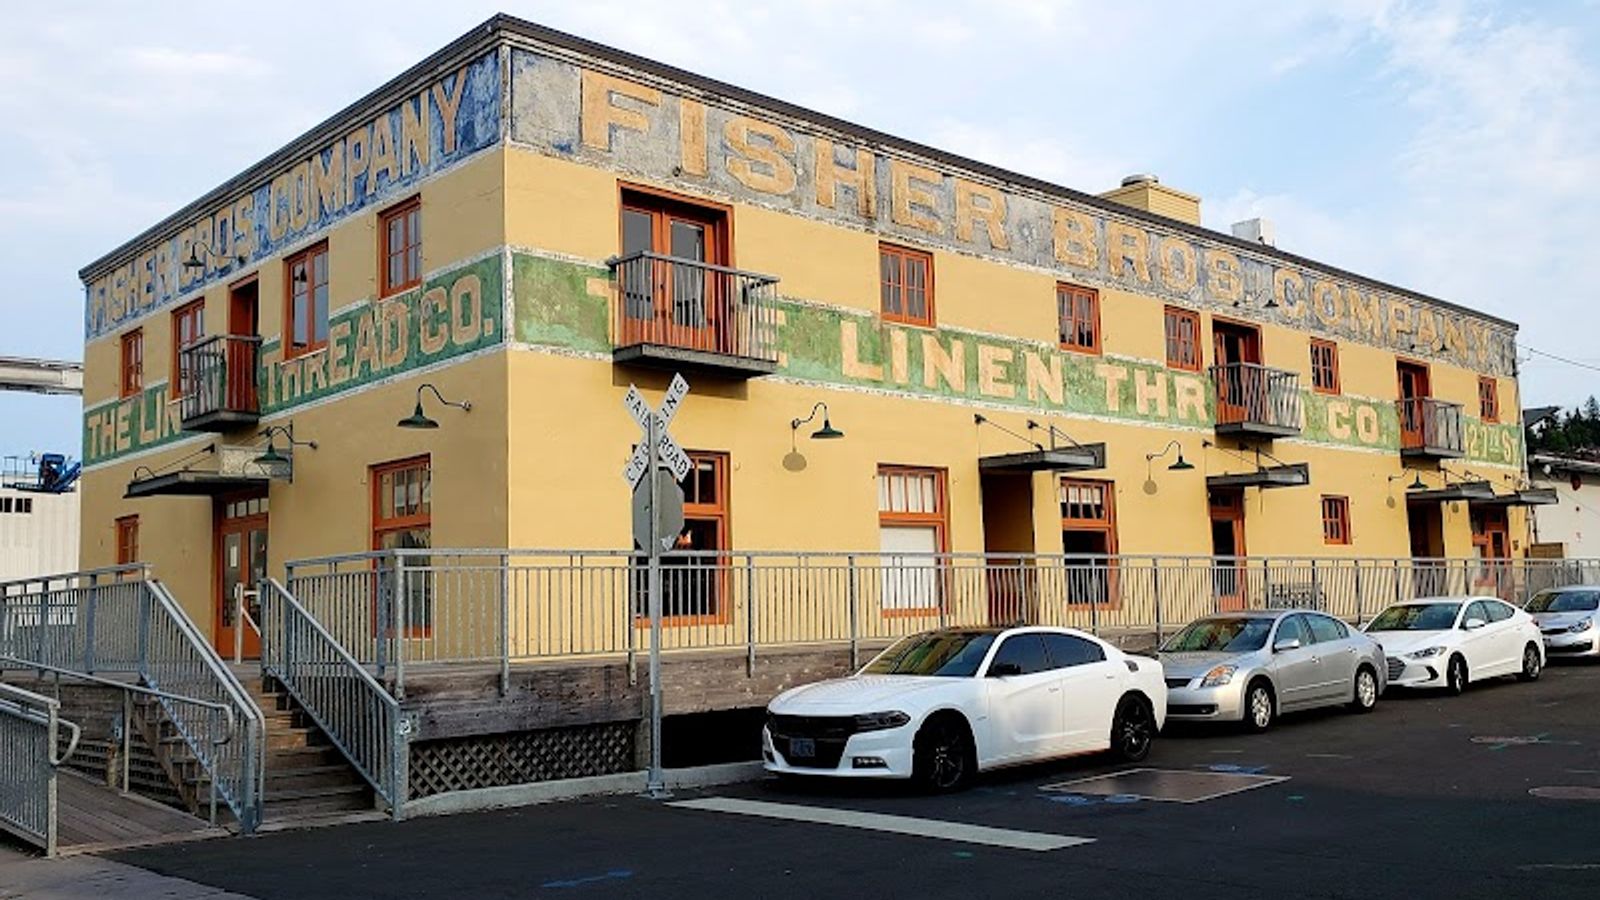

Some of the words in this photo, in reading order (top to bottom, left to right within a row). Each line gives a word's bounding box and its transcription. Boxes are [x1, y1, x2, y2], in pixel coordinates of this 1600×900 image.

[89, 243, 169, 330] FISHER
[267, 67, 467, 242] COMPANY
[580, 67, 1011, 250] FISHER
[1053, 206, 1243, 299] BROS
[1273, 267, 1491, 363] COMPANY
[88, 400, 132, 460] THE
[263, 299, 408, 406] THREAD
[419, 275, 494, 355] CO.
[841, 321, 1064, 405] LINEN
